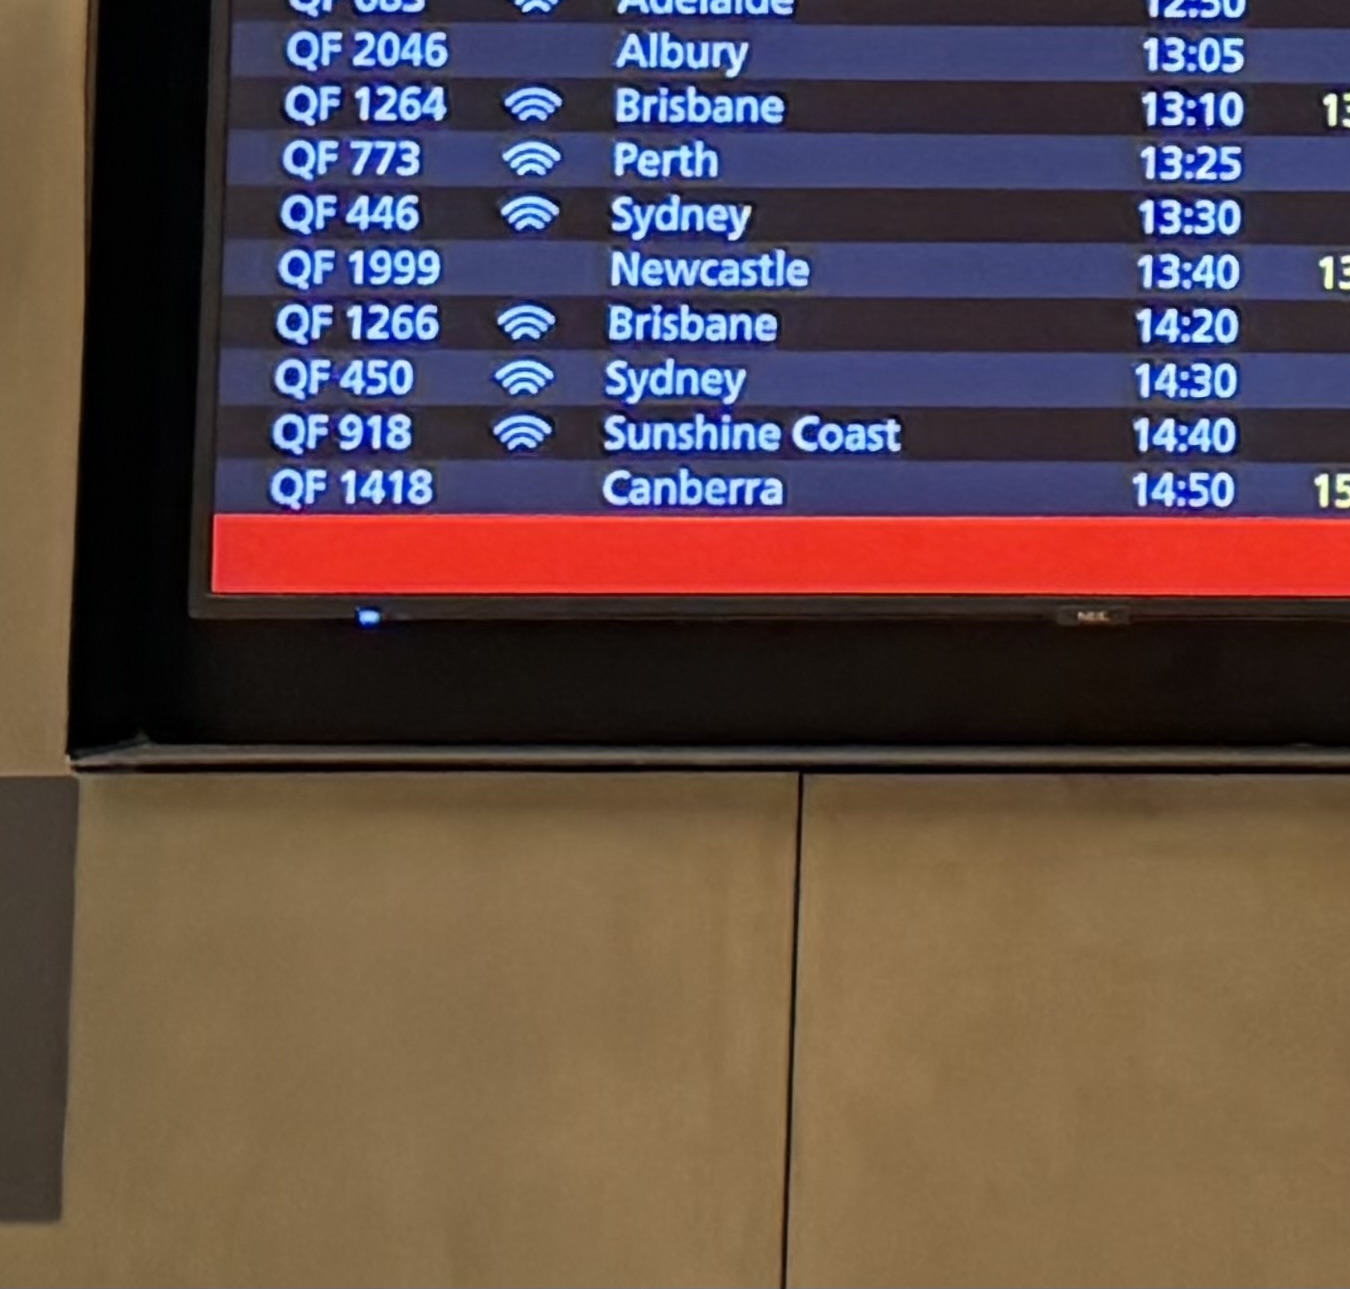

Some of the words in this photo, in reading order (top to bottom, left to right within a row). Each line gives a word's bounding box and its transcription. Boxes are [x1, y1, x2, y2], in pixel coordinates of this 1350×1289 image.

[286, 30, 344, 72] QF
[351, 30, 449, 68] 2046
[614, 30, 750, 79] Albury
[1142, 35, 1246, 74] 13:05
[284, 84, 342, 127] QF
[353, 84, 448, 122] 1264
[615, 85, 786, 125] Brisbane
[1140, 90, 1245, 128] 13:10
[277, 248, 336, 291] QF
[347, 248, 442, 287] 1999
[610, 248, 811, 288] Newcastle
[1136, 252, 1241, 291] 13:40
[274, 358, 332, 401] QF
[338, 358, 415, 396] 450
[605, 357, 748, 406] Sydney
[1134, 362, 1238, 399] 14:30
[270, 467, 328, 511] QF
[339, 468, 434, 506] 1418
[601, 467, 784, 507] Canberra
[1131, 470, 1236, 509] 14:50
